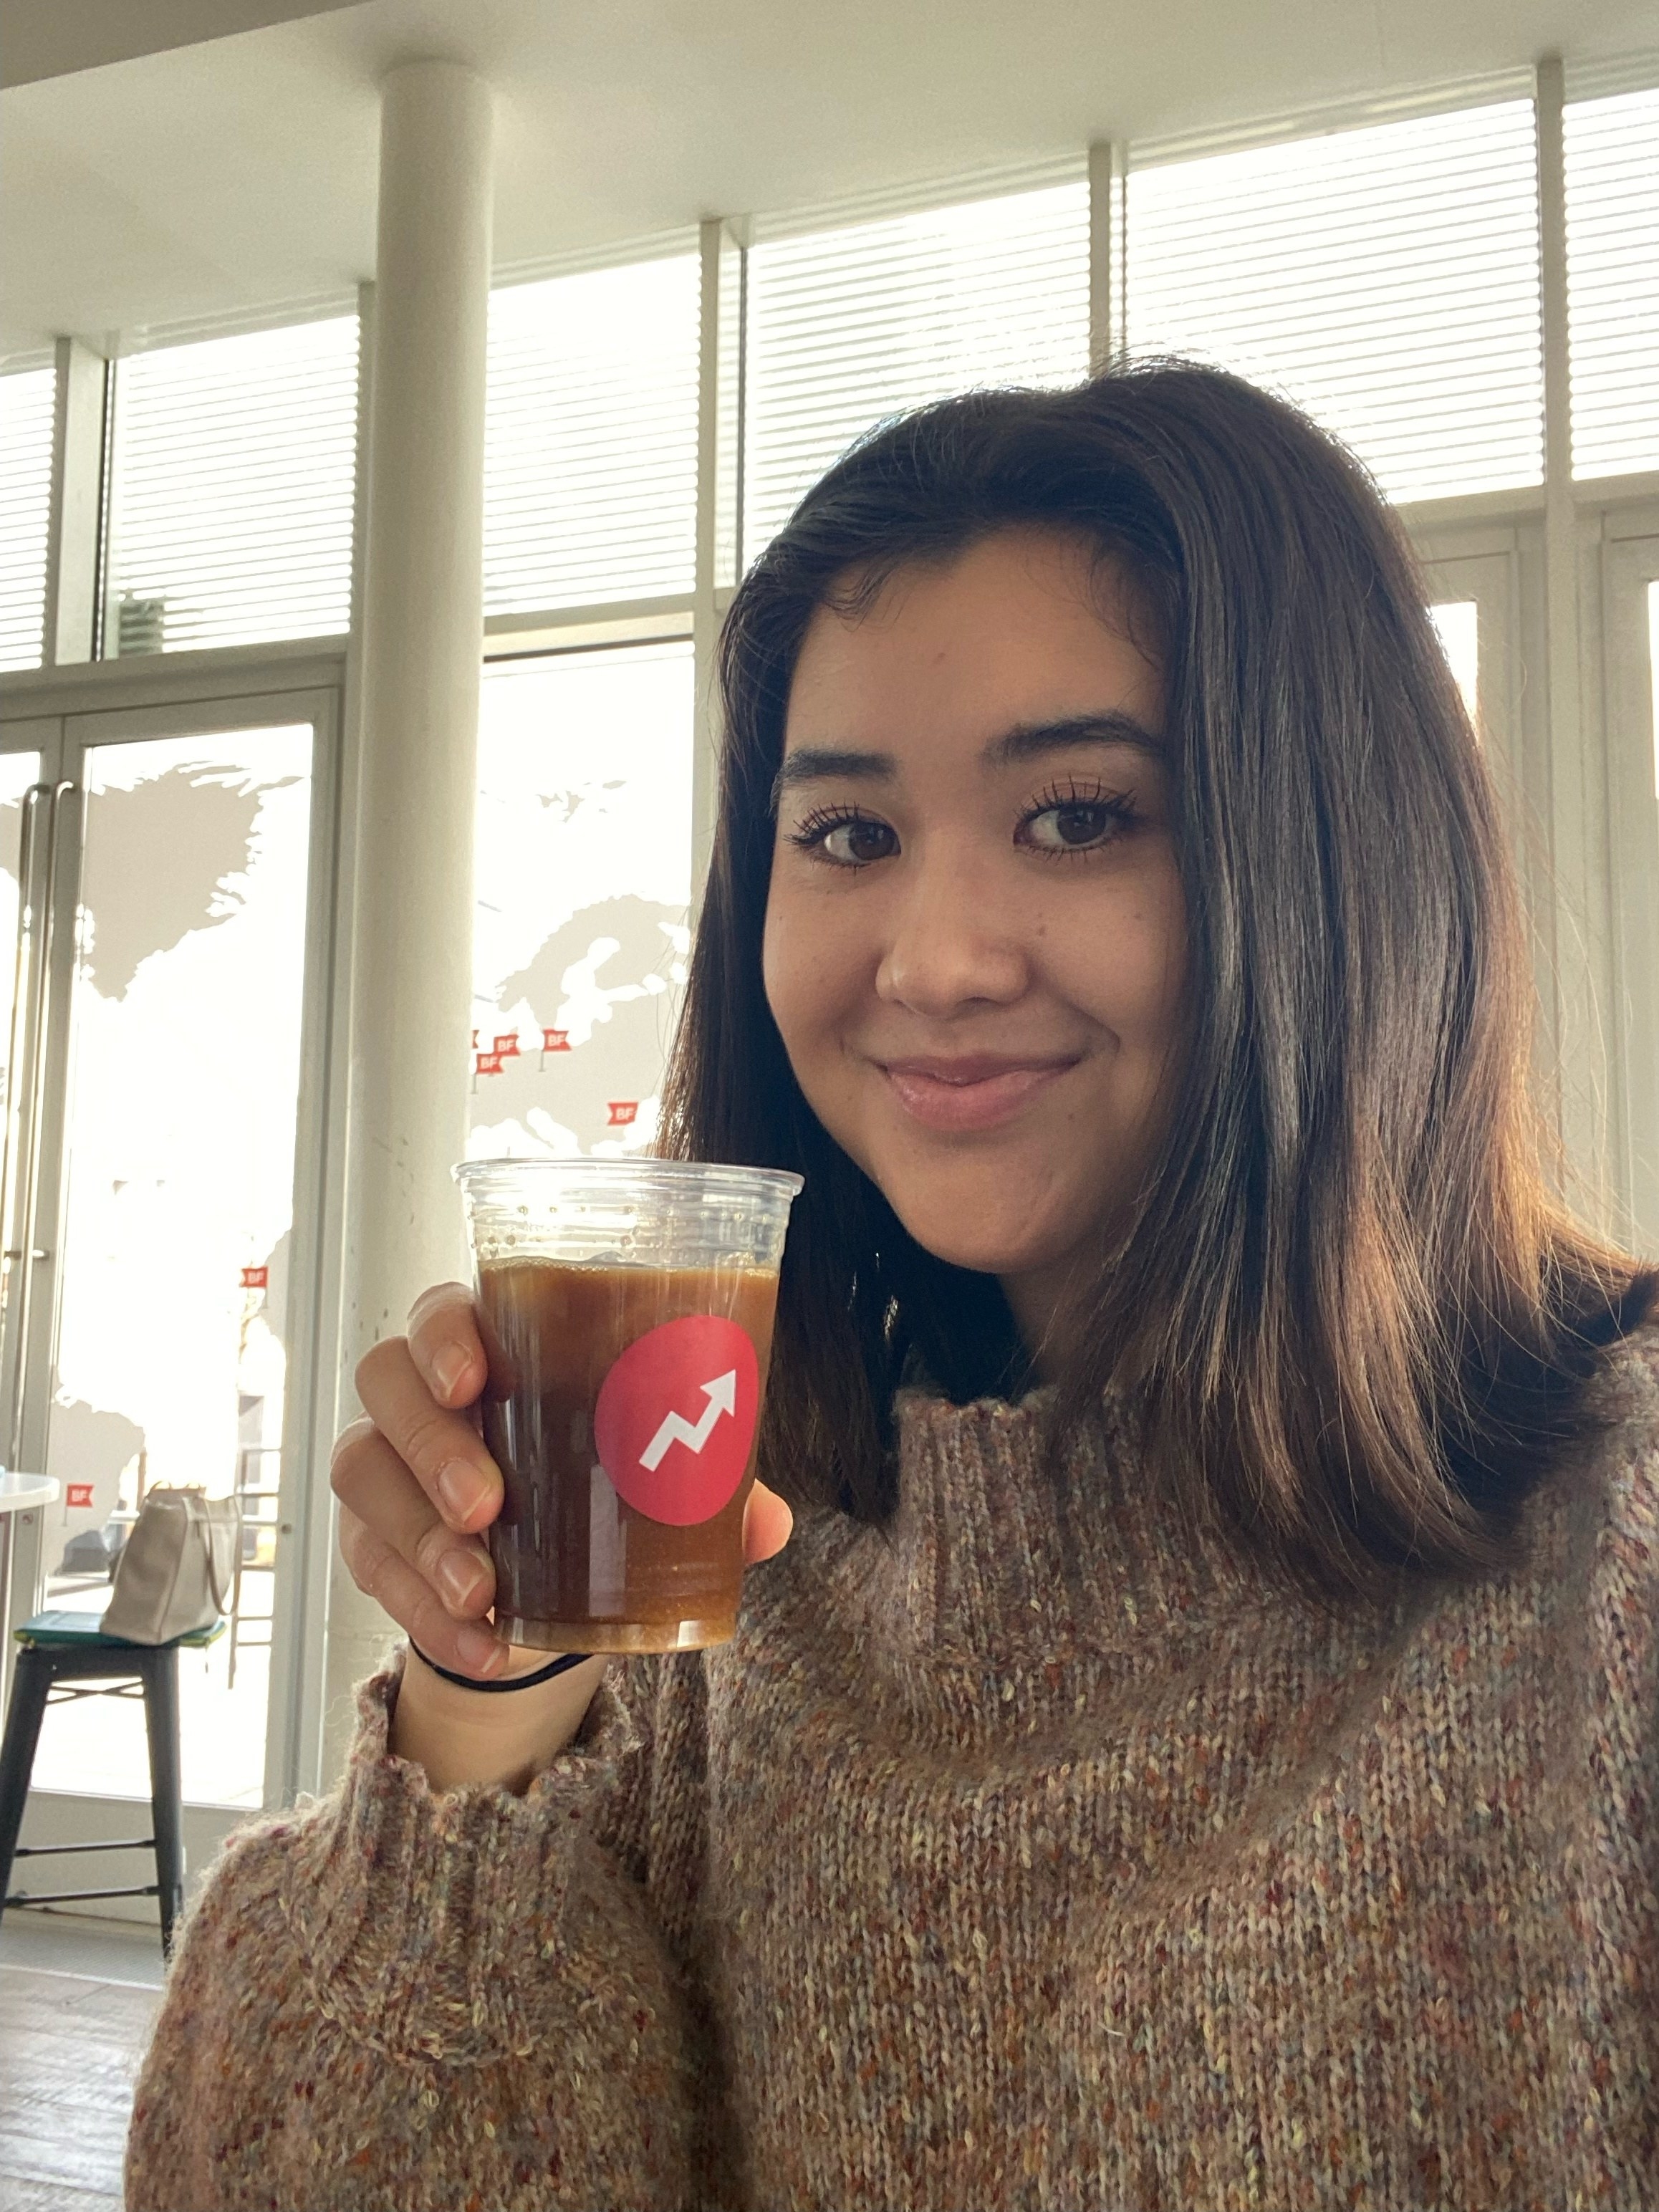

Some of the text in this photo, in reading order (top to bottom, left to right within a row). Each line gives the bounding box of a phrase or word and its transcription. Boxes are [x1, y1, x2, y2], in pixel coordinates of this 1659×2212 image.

[497, 1039, 515, 1052] BF
[547, 1034, 566, 1047] BF
[480, 1056, 498, 1069] BF
[615, 1107, 635, 1121] BF
[71, 1489, 87, 1502] BF
